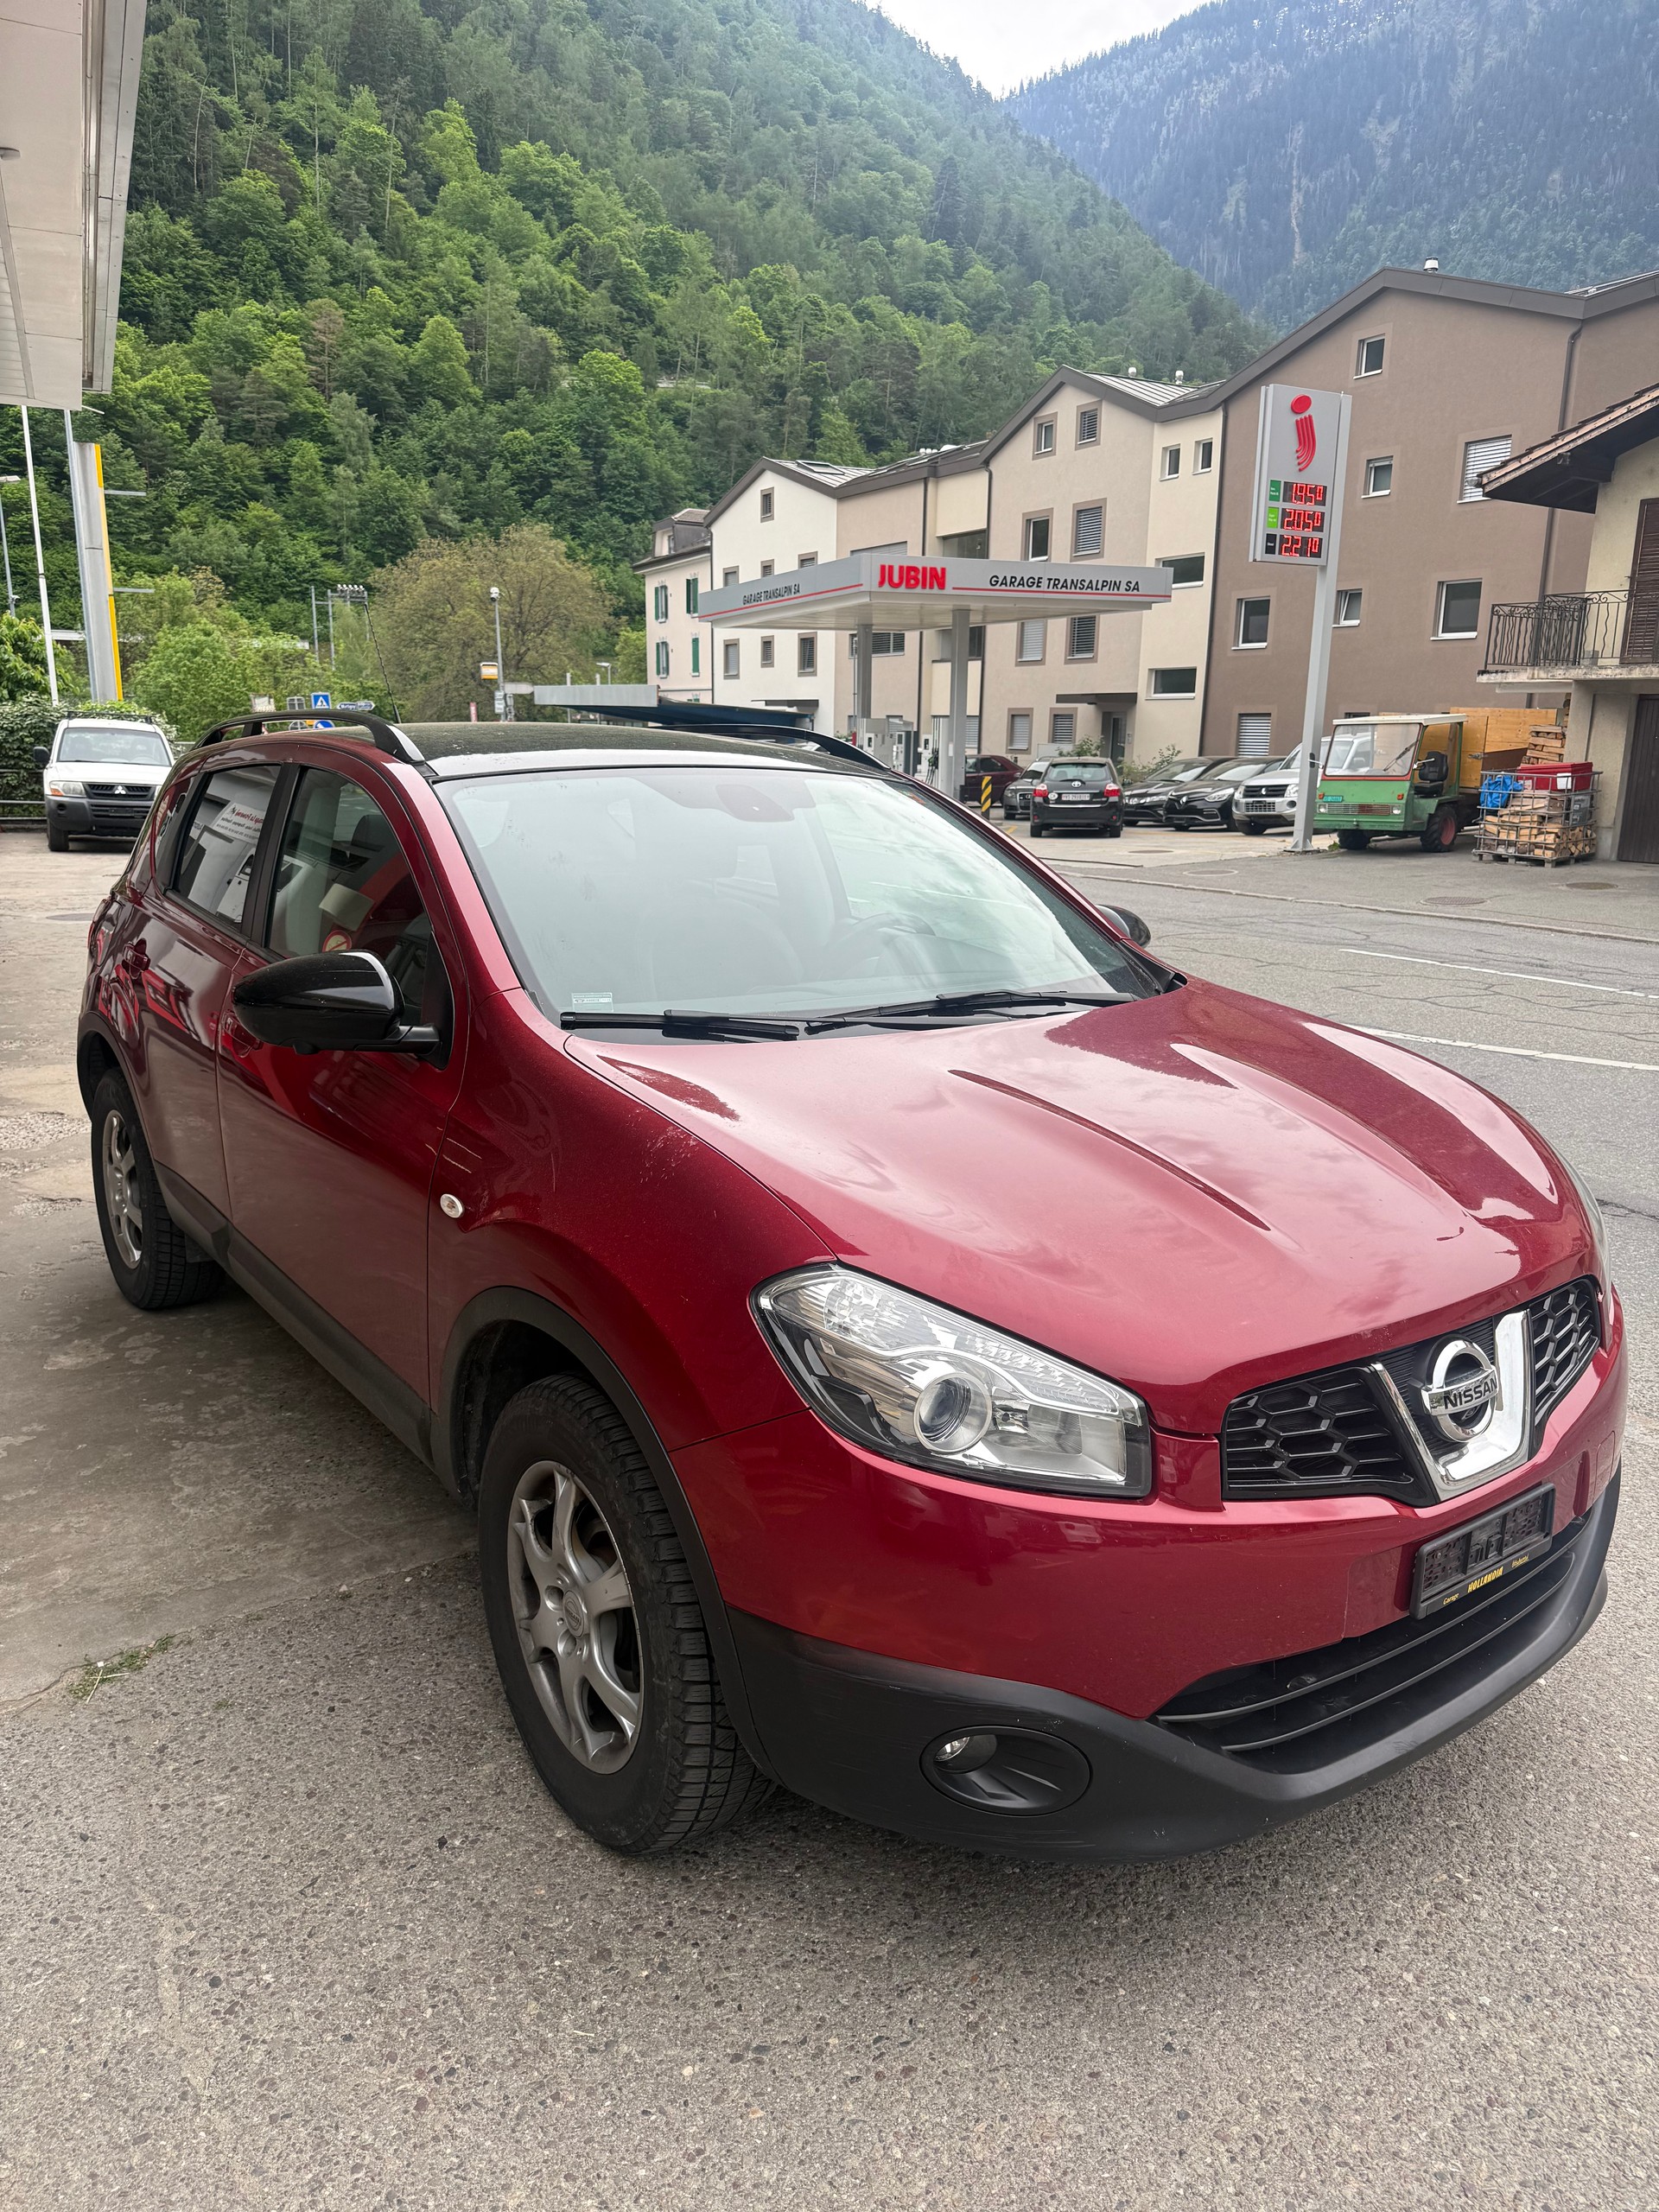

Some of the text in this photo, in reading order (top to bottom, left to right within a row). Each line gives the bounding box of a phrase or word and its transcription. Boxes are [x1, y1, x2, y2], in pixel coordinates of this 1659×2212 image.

[878, 563, 946, 590] JUBIN
[988, 575, 1141, 592] GARAGE TRANSALPIN SA
[743, 583, 800, 605] GARAGE TRANSALPIN SA
[1443, 1377, 1498, 1410] NISSAN
[1443, 1567, 1503, 1605] Garage HOLLANDIA
